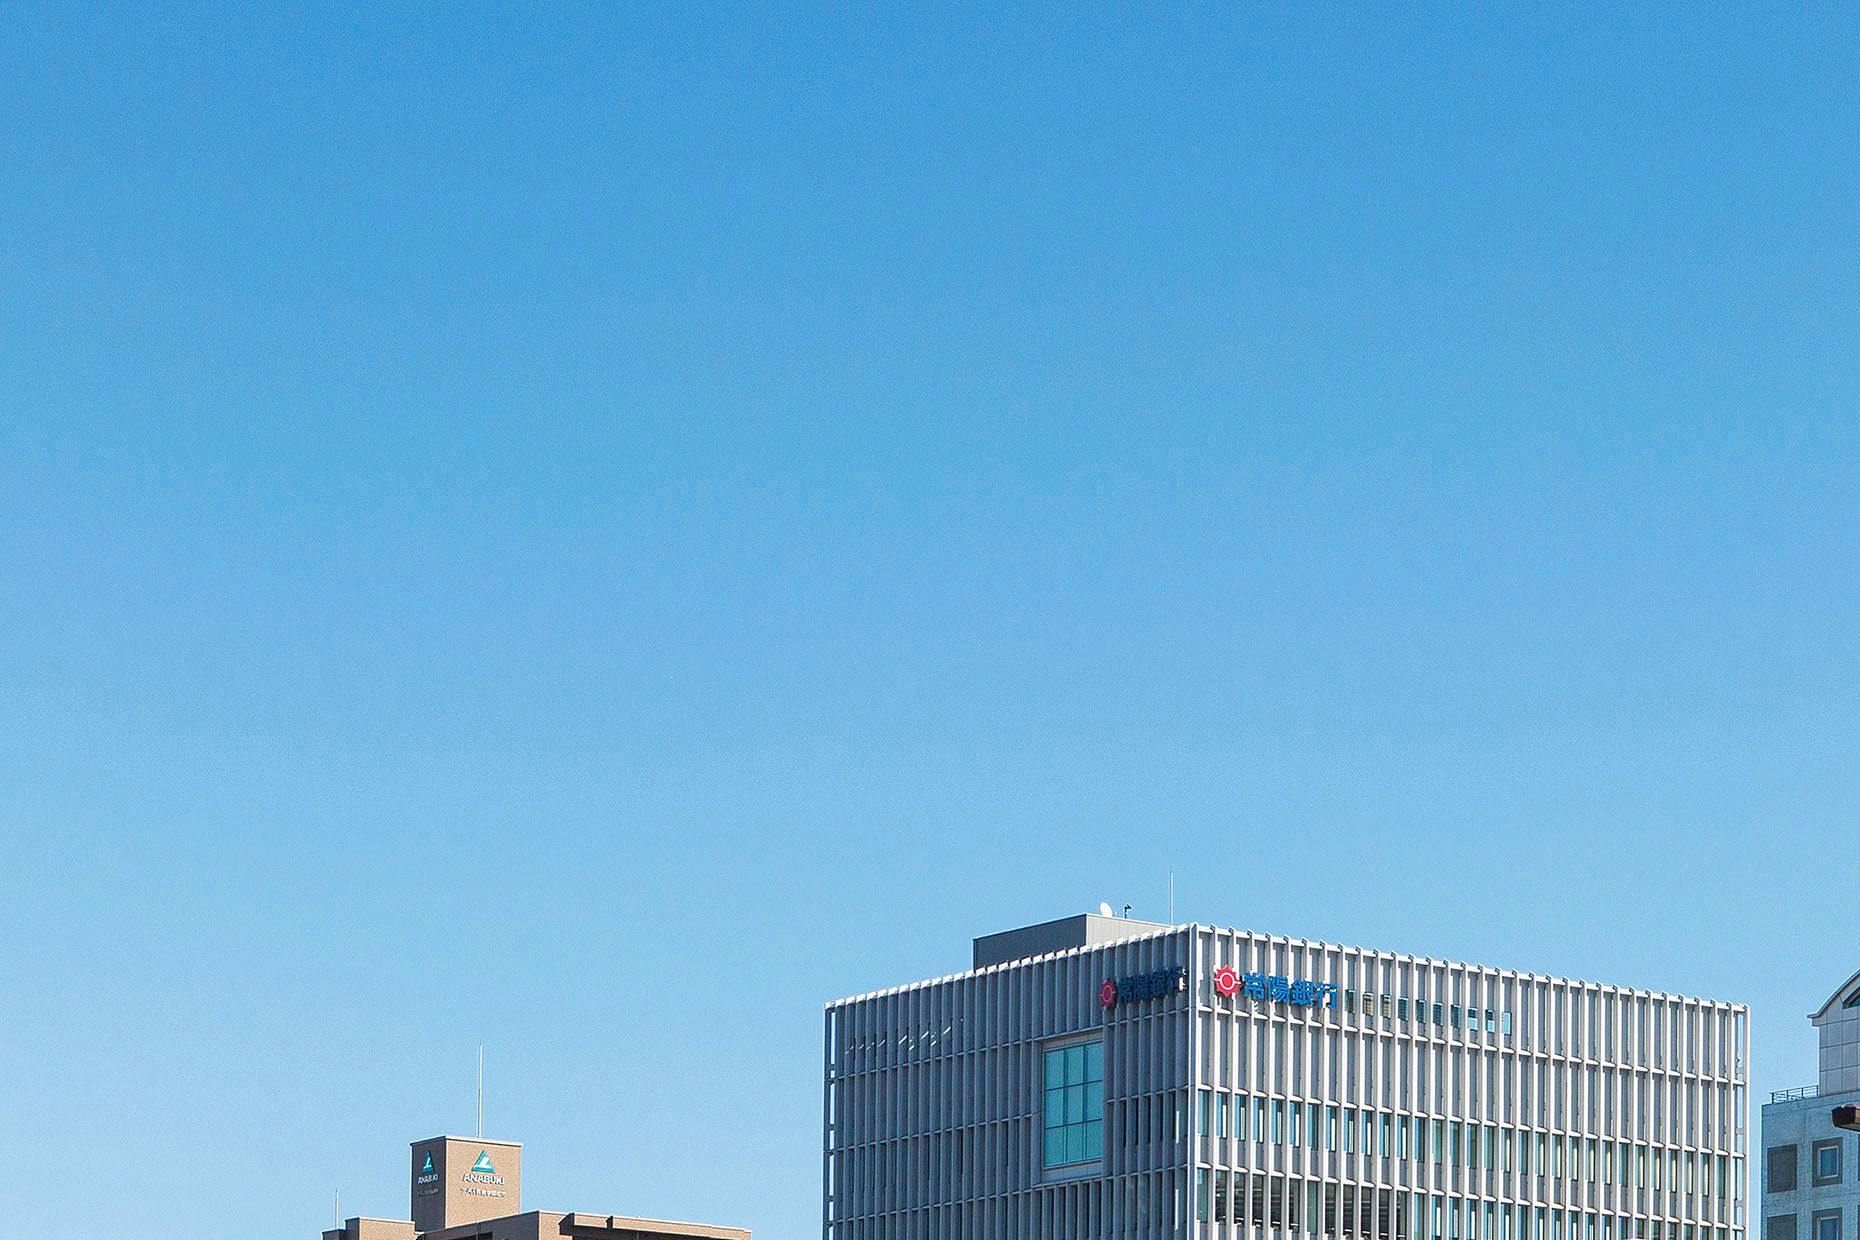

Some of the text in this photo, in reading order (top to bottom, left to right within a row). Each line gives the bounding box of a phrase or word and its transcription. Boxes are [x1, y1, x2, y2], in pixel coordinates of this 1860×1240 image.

[1244, 972, 1340, 1010] 常陽銀行
[463, 1173, 505, 1186] ANABUKI
